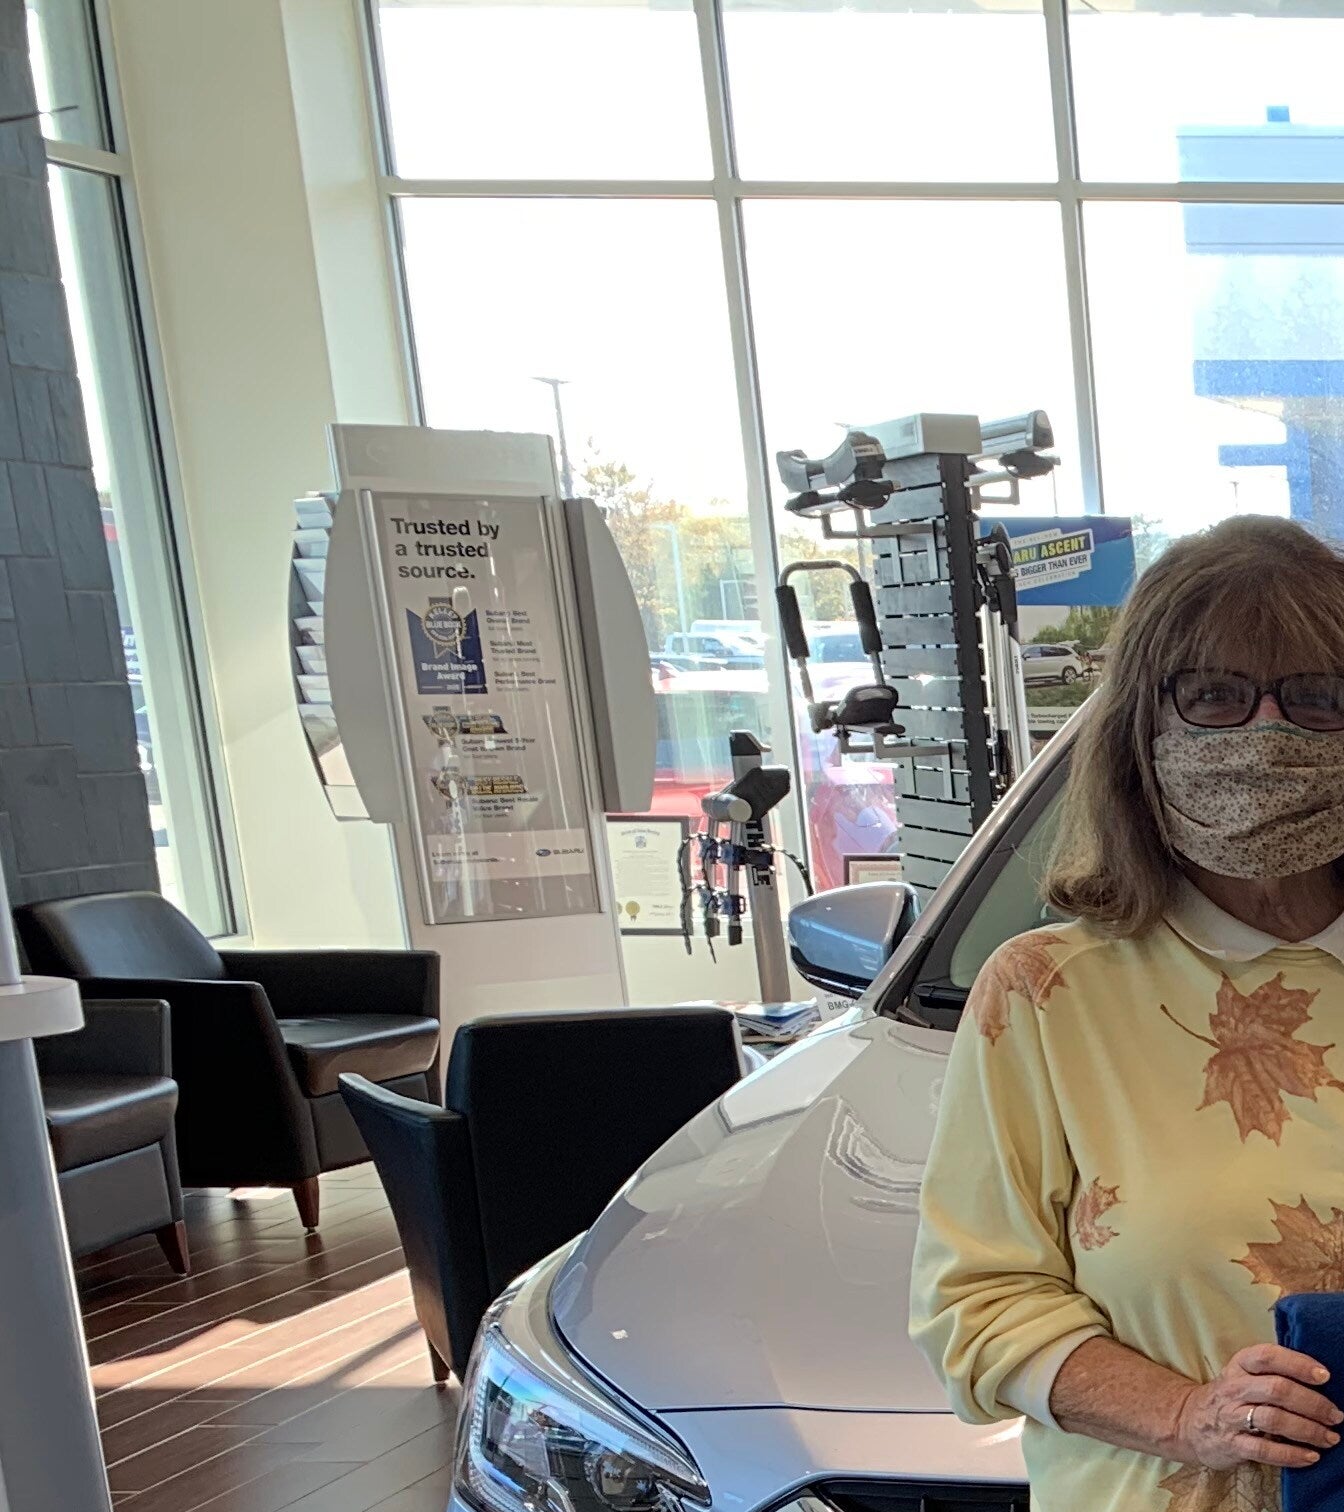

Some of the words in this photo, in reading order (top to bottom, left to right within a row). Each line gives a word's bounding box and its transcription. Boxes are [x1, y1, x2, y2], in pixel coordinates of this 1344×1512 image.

[390, 518, 471, 536] Trusted
[477, 520, 500, 540] by
[395, 543, 408, 557] a
[415, 541, 489, 558] trusted
[1013, 546, 1037, 564] ARU
[1040, 536, 1086, 558] ASCENT
[398, 564, 476, 579] source.
[1020, 562, 1047, 576] BIGGER
[1048, 558, 1068, 571] THAN
[1069, 553, 1088, 567] EVER
[421, 662, 449, 671] Brand
[450, 662, 478, 673] Image
[437, 671, 466, 680] Award
[745, 819, 771, 886] THLE
